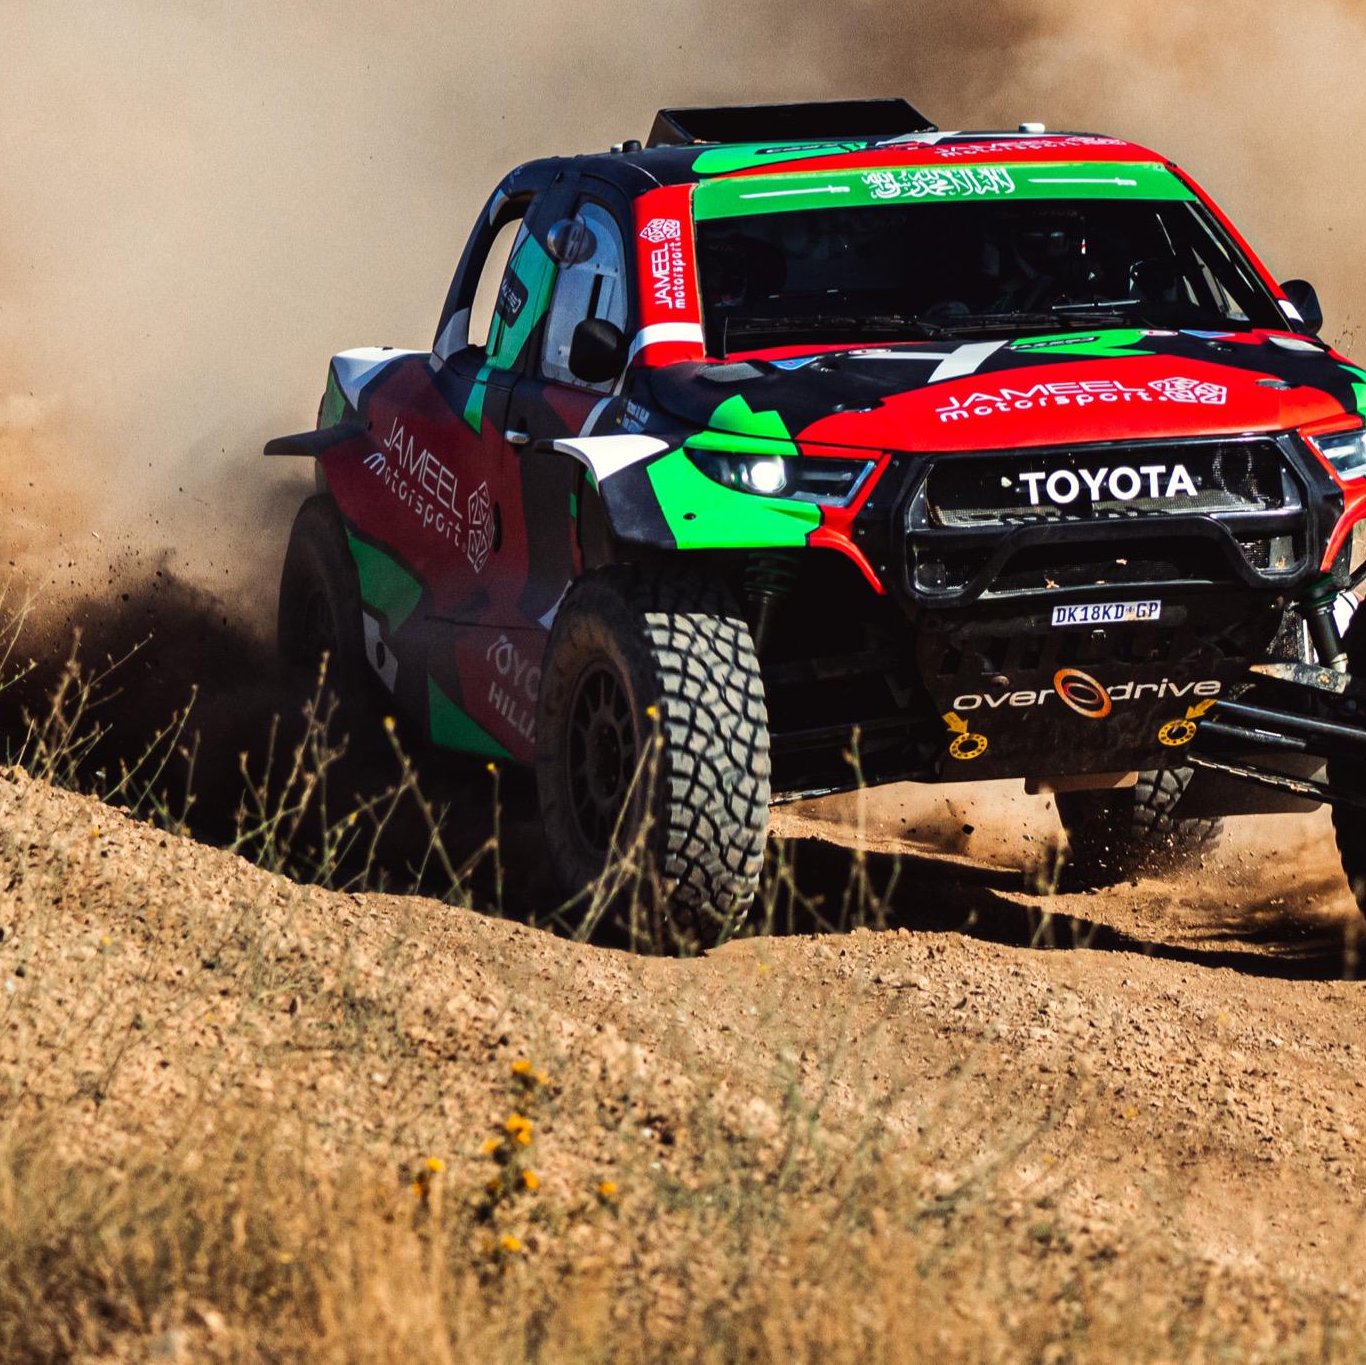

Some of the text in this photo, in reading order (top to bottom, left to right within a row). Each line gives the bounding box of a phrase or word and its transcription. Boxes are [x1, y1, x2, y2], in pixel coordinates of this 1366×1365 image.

[651, 242, 673, 310] JAMEEL
[935, 380, 1146, 412] JAMEEL
[384, 416, 463, 519] JAMEEL
[1019, 464, 1198, 505] TOYOTA
[486, 634, 542, 702] TOYO
[488, 680, 536, 744] HILU
